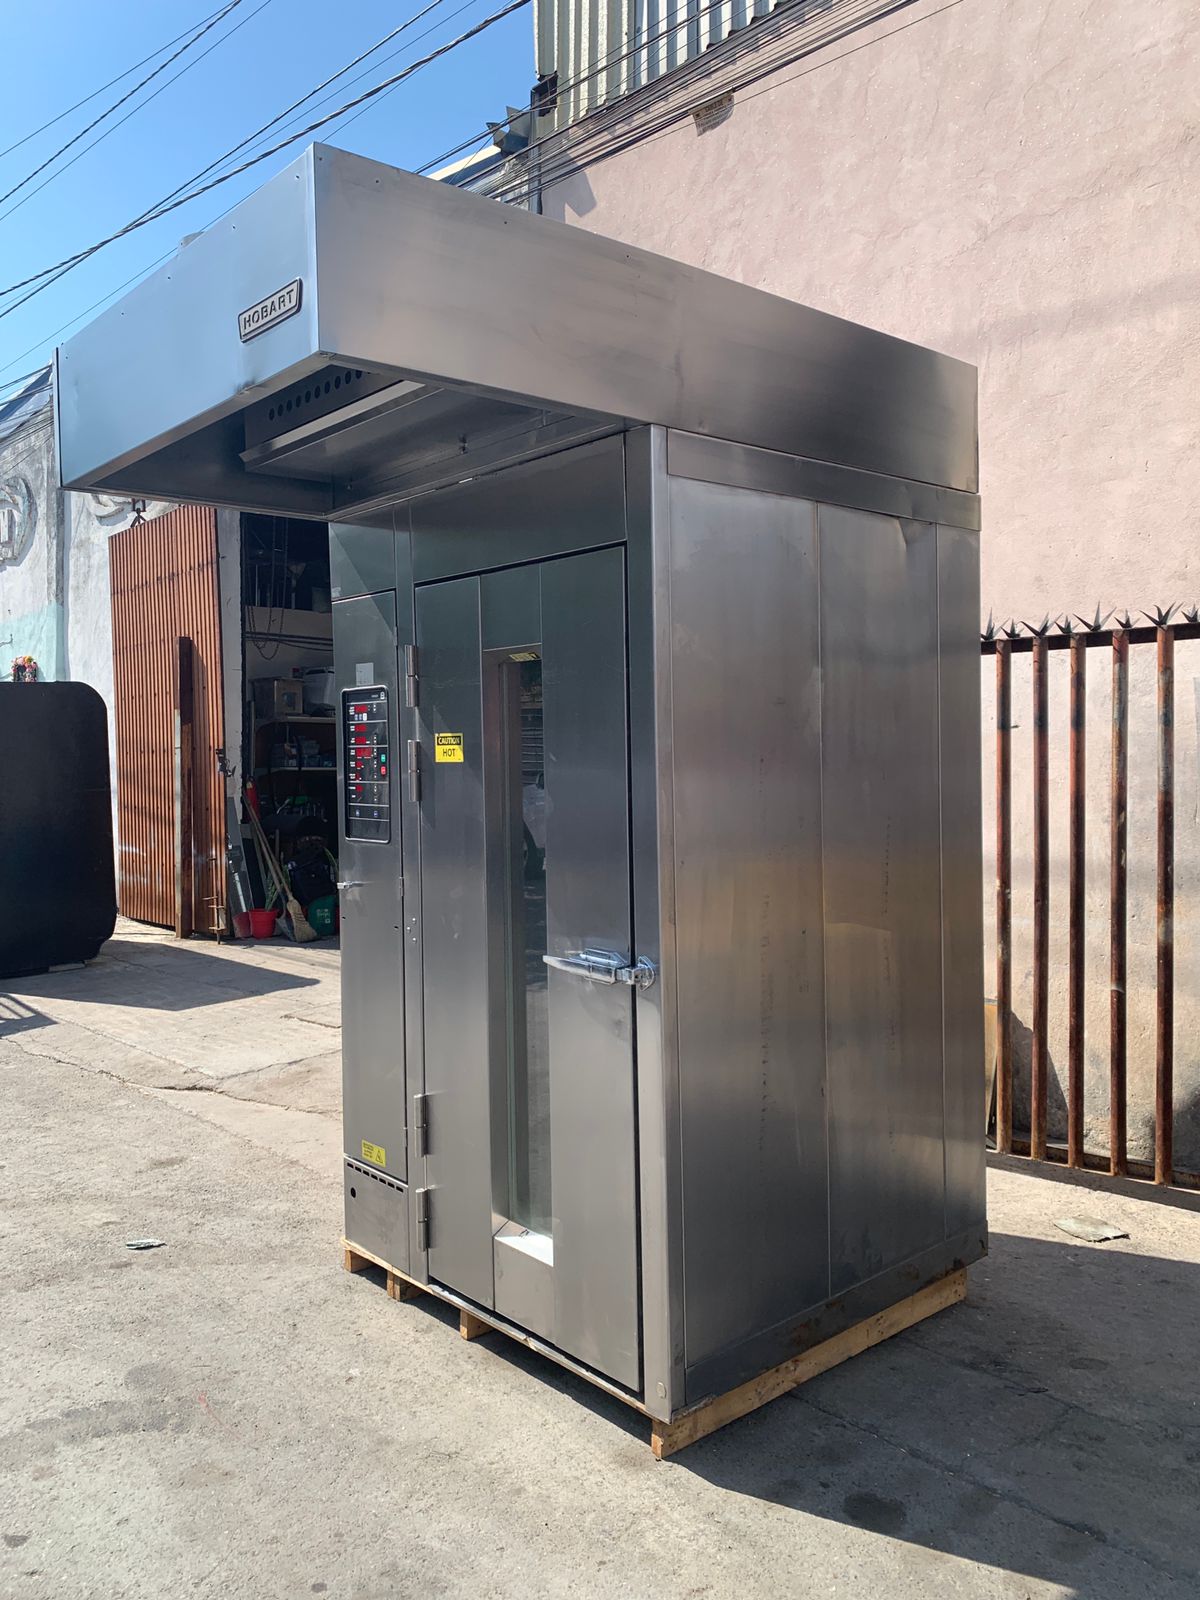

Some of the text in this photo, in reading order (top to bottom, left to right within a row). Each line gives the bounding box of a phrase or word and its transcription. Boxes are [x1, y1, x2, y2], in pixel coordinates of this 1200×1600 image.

[242, 288, 295, 330] HOBART
[438, 737, 461, 745] CAUTION
[442, 748, 456, 758] HOT
